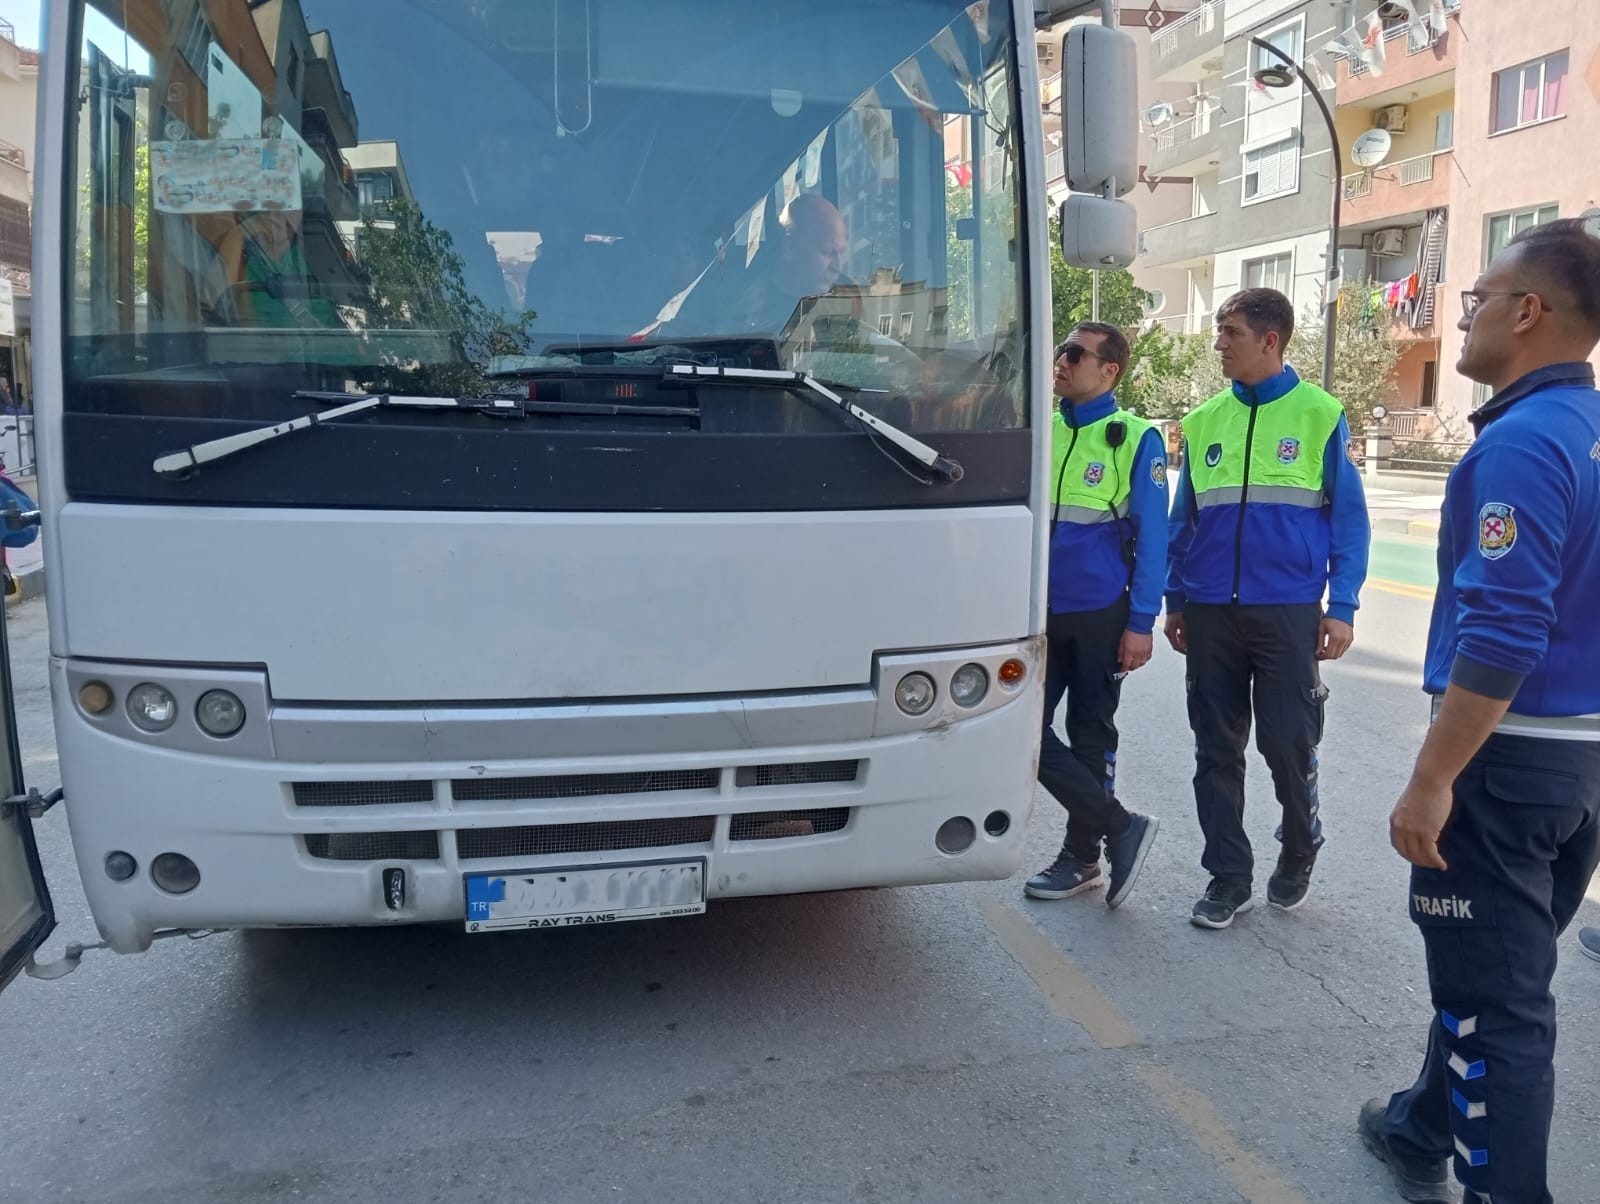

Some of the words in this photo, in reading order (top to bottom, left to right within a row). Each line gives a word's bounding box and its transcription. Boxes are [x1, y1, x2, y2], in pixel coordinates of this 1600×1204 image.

[471, 901, 487, 912] TR
[1412, 894, 1474, 919] TRAFİK
[528, 917, 560, 928] RAY
[565, 913, 616, 925] TRANS
